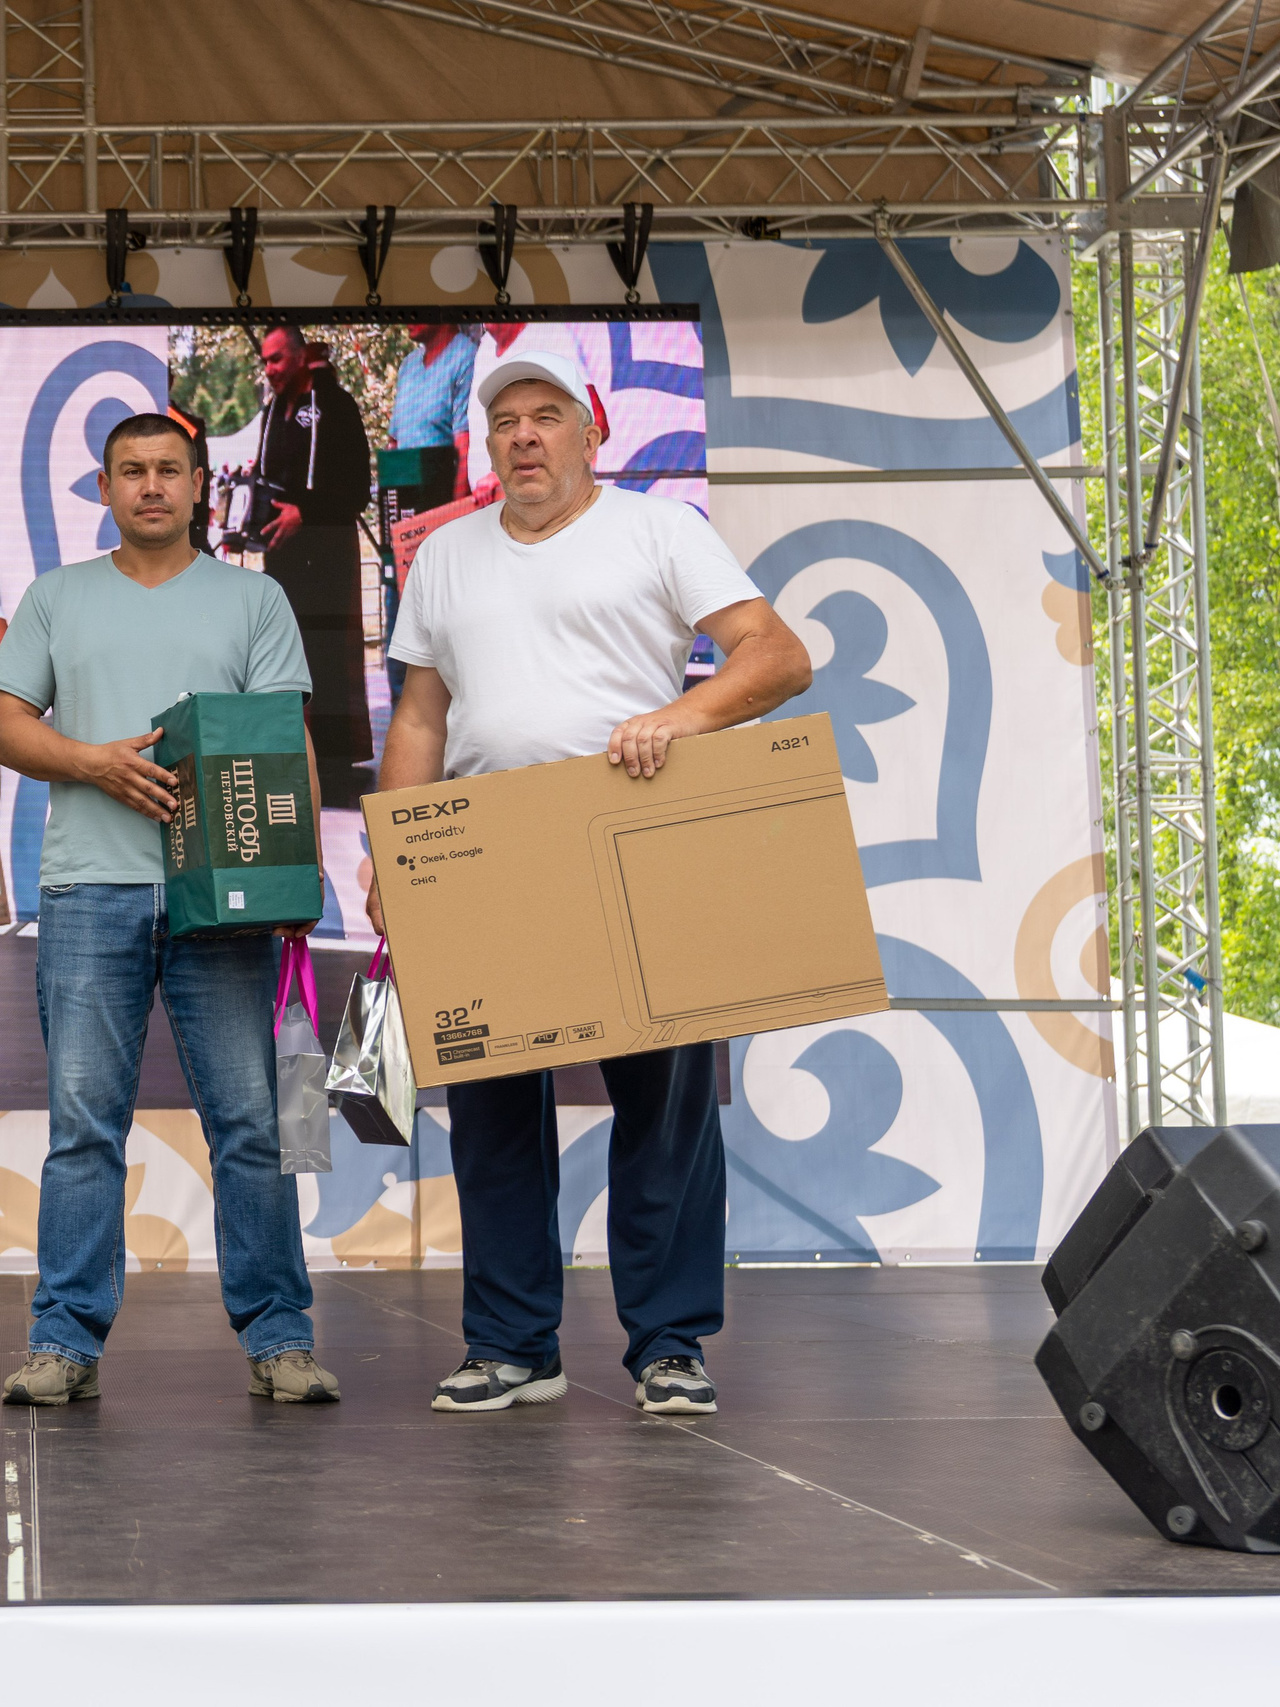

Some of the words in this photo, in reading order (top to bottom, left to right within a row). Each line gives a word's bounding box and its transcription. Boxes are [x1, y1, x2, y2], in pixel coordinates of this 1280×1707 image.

[771, 735, 809, 752] A321
[232, 759, 261, 862] ШТОФЪ
[391, 798, 470, 825] DEXP
[420, 852, 448, 864] Окей,
[449, 846, 483, 859] Google
[435, 998, 483, 1029] 32"
[440, 1028, 483, 1041] 1366x768
[572, 1024, 596, 1034] SMART
[578, 1031, 596, 1040] TV
[537, 1032, 554, 1042] HD
[452, 1046, 480, 1055] Chromecast
